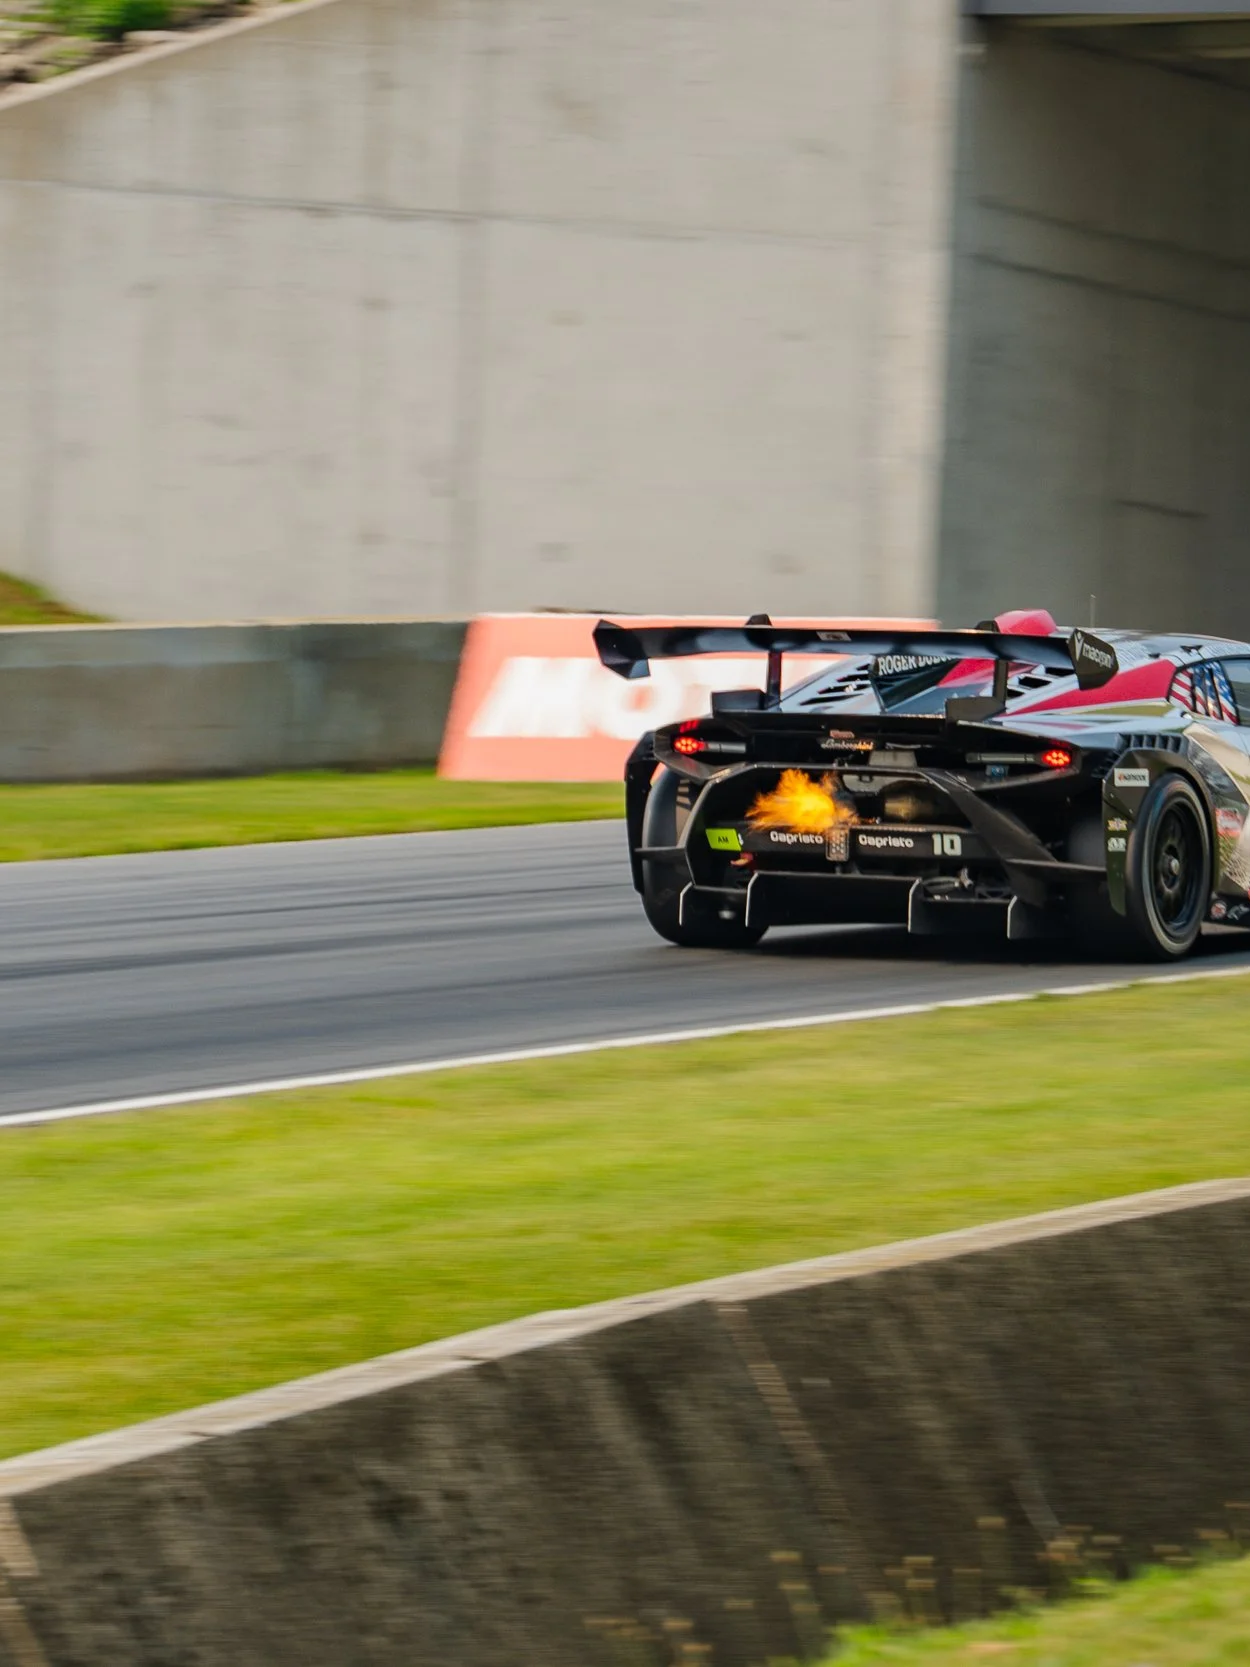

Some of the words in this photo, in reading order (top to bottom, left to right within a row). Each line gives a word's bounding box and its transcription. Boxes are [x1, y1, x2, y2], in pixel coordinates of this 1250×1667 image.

[877, 655, 917, 676] ROGER
[769, 830, 824, 845] Capristo
[858, 834, 914, 848] Capristo
[931, 833, 962, 856] 10
